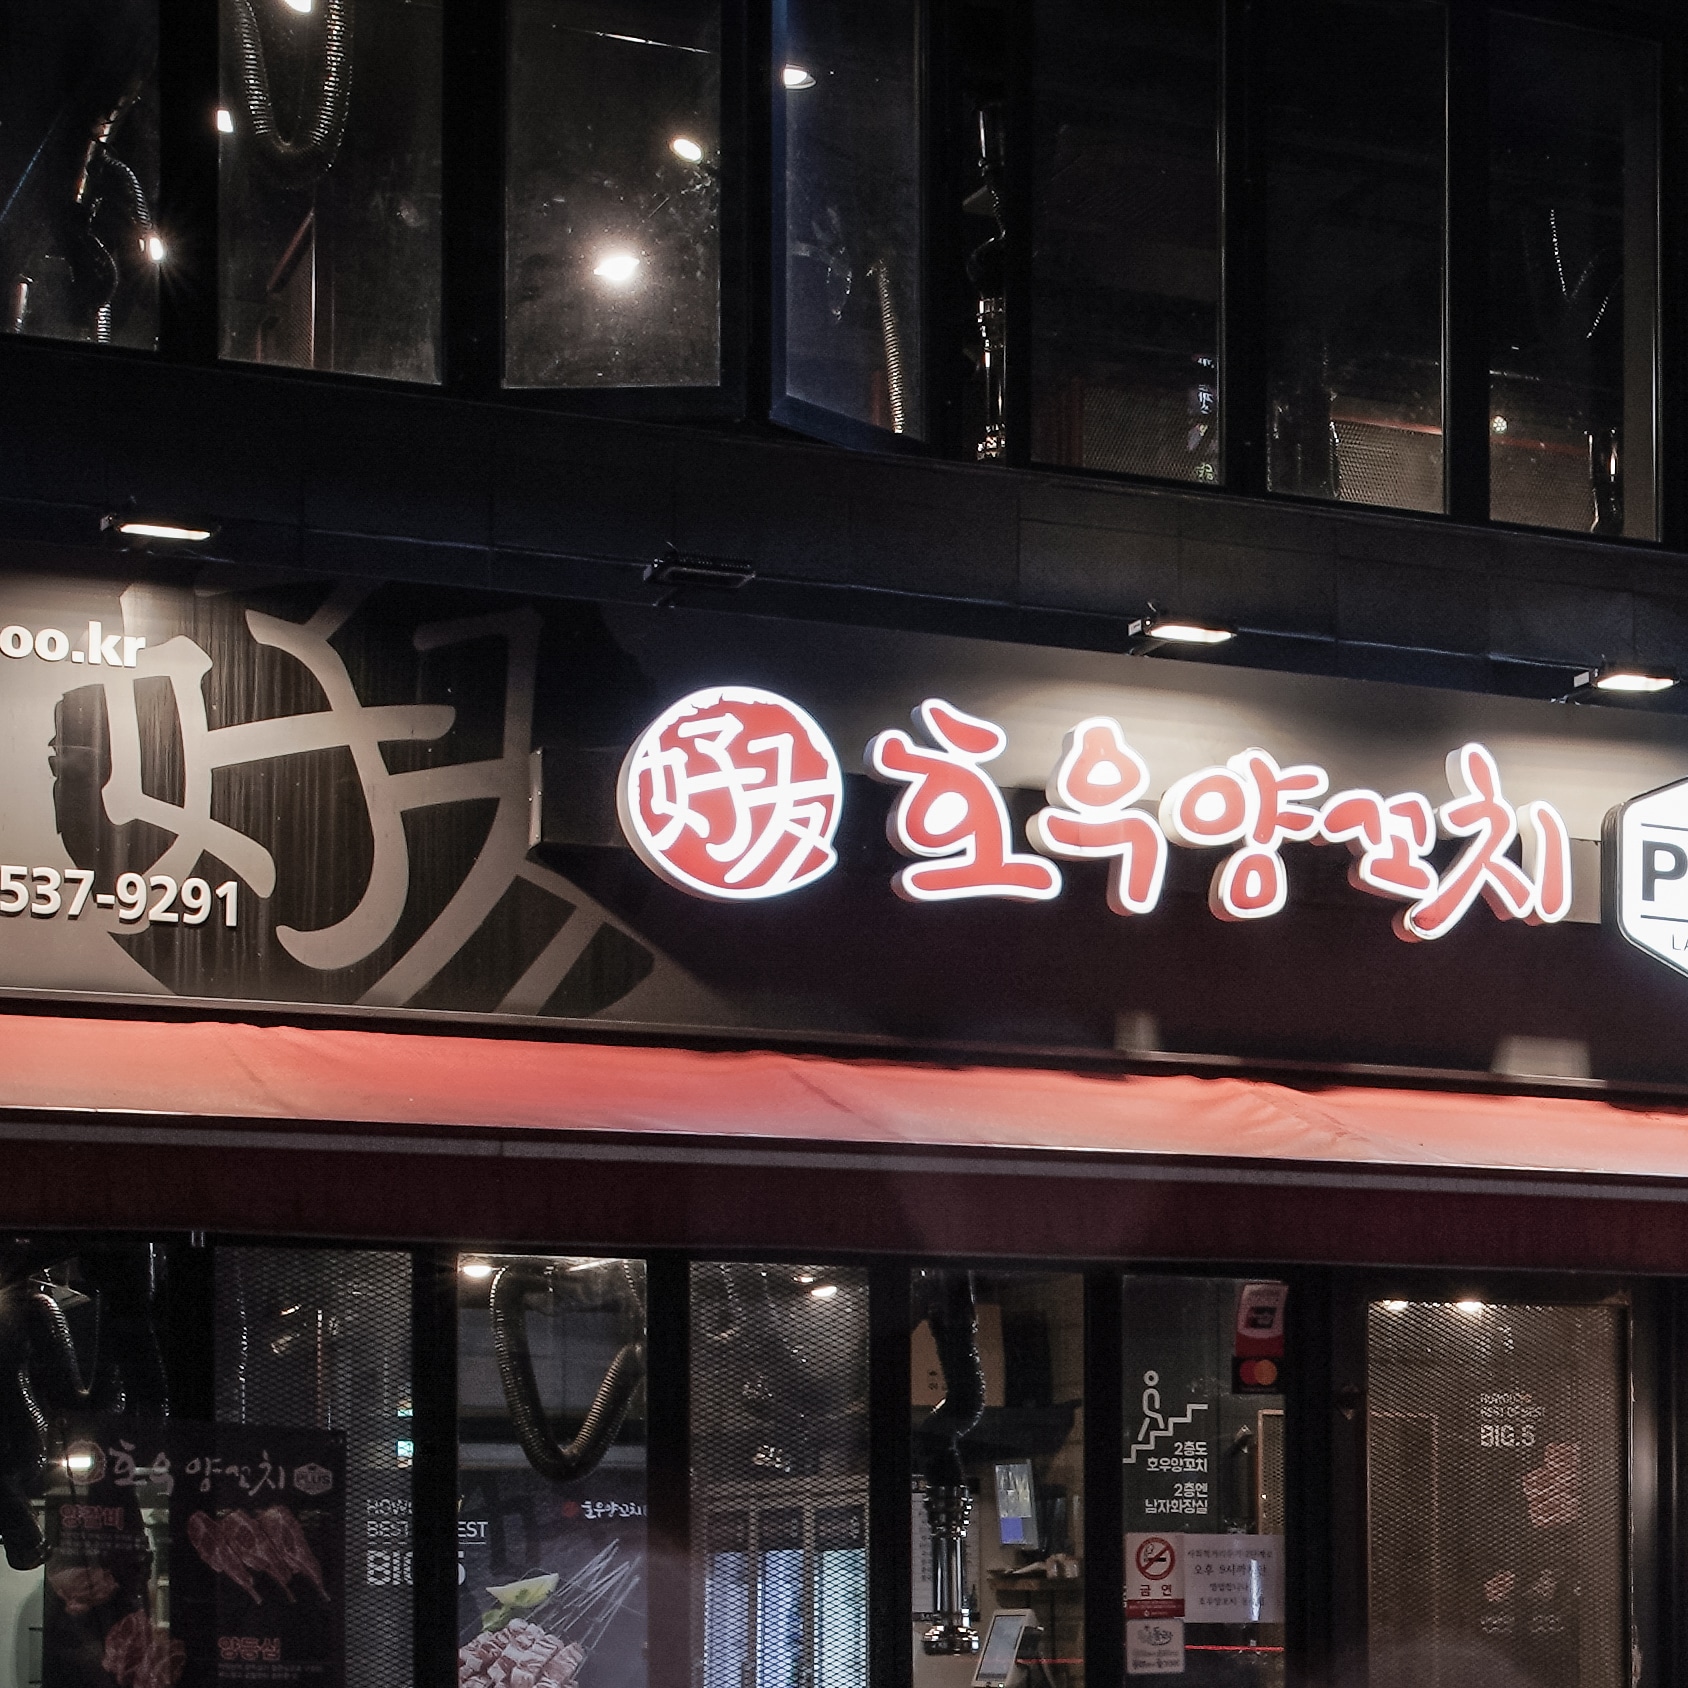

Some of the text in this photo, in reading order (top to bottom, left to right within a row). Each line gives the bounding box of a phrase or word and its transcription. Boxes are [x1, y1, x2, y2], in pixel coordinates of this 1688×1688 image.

[0, 620, 147, 669] oo.kr
[866, 698, 1572, 941] 호우양꼬치
[0, 864, 239, 928] 537-9291
[1480, 1424, 1536, 1448] BIG.5
[1173, 1440, 1209, 1457] 2층도
[1146, 1457, 1208, 1473] 호우양꼬치
[1173, 1481, 1209, 1498] 2층엔
[1144, 1498, 1208, 1515] 남자화장실
